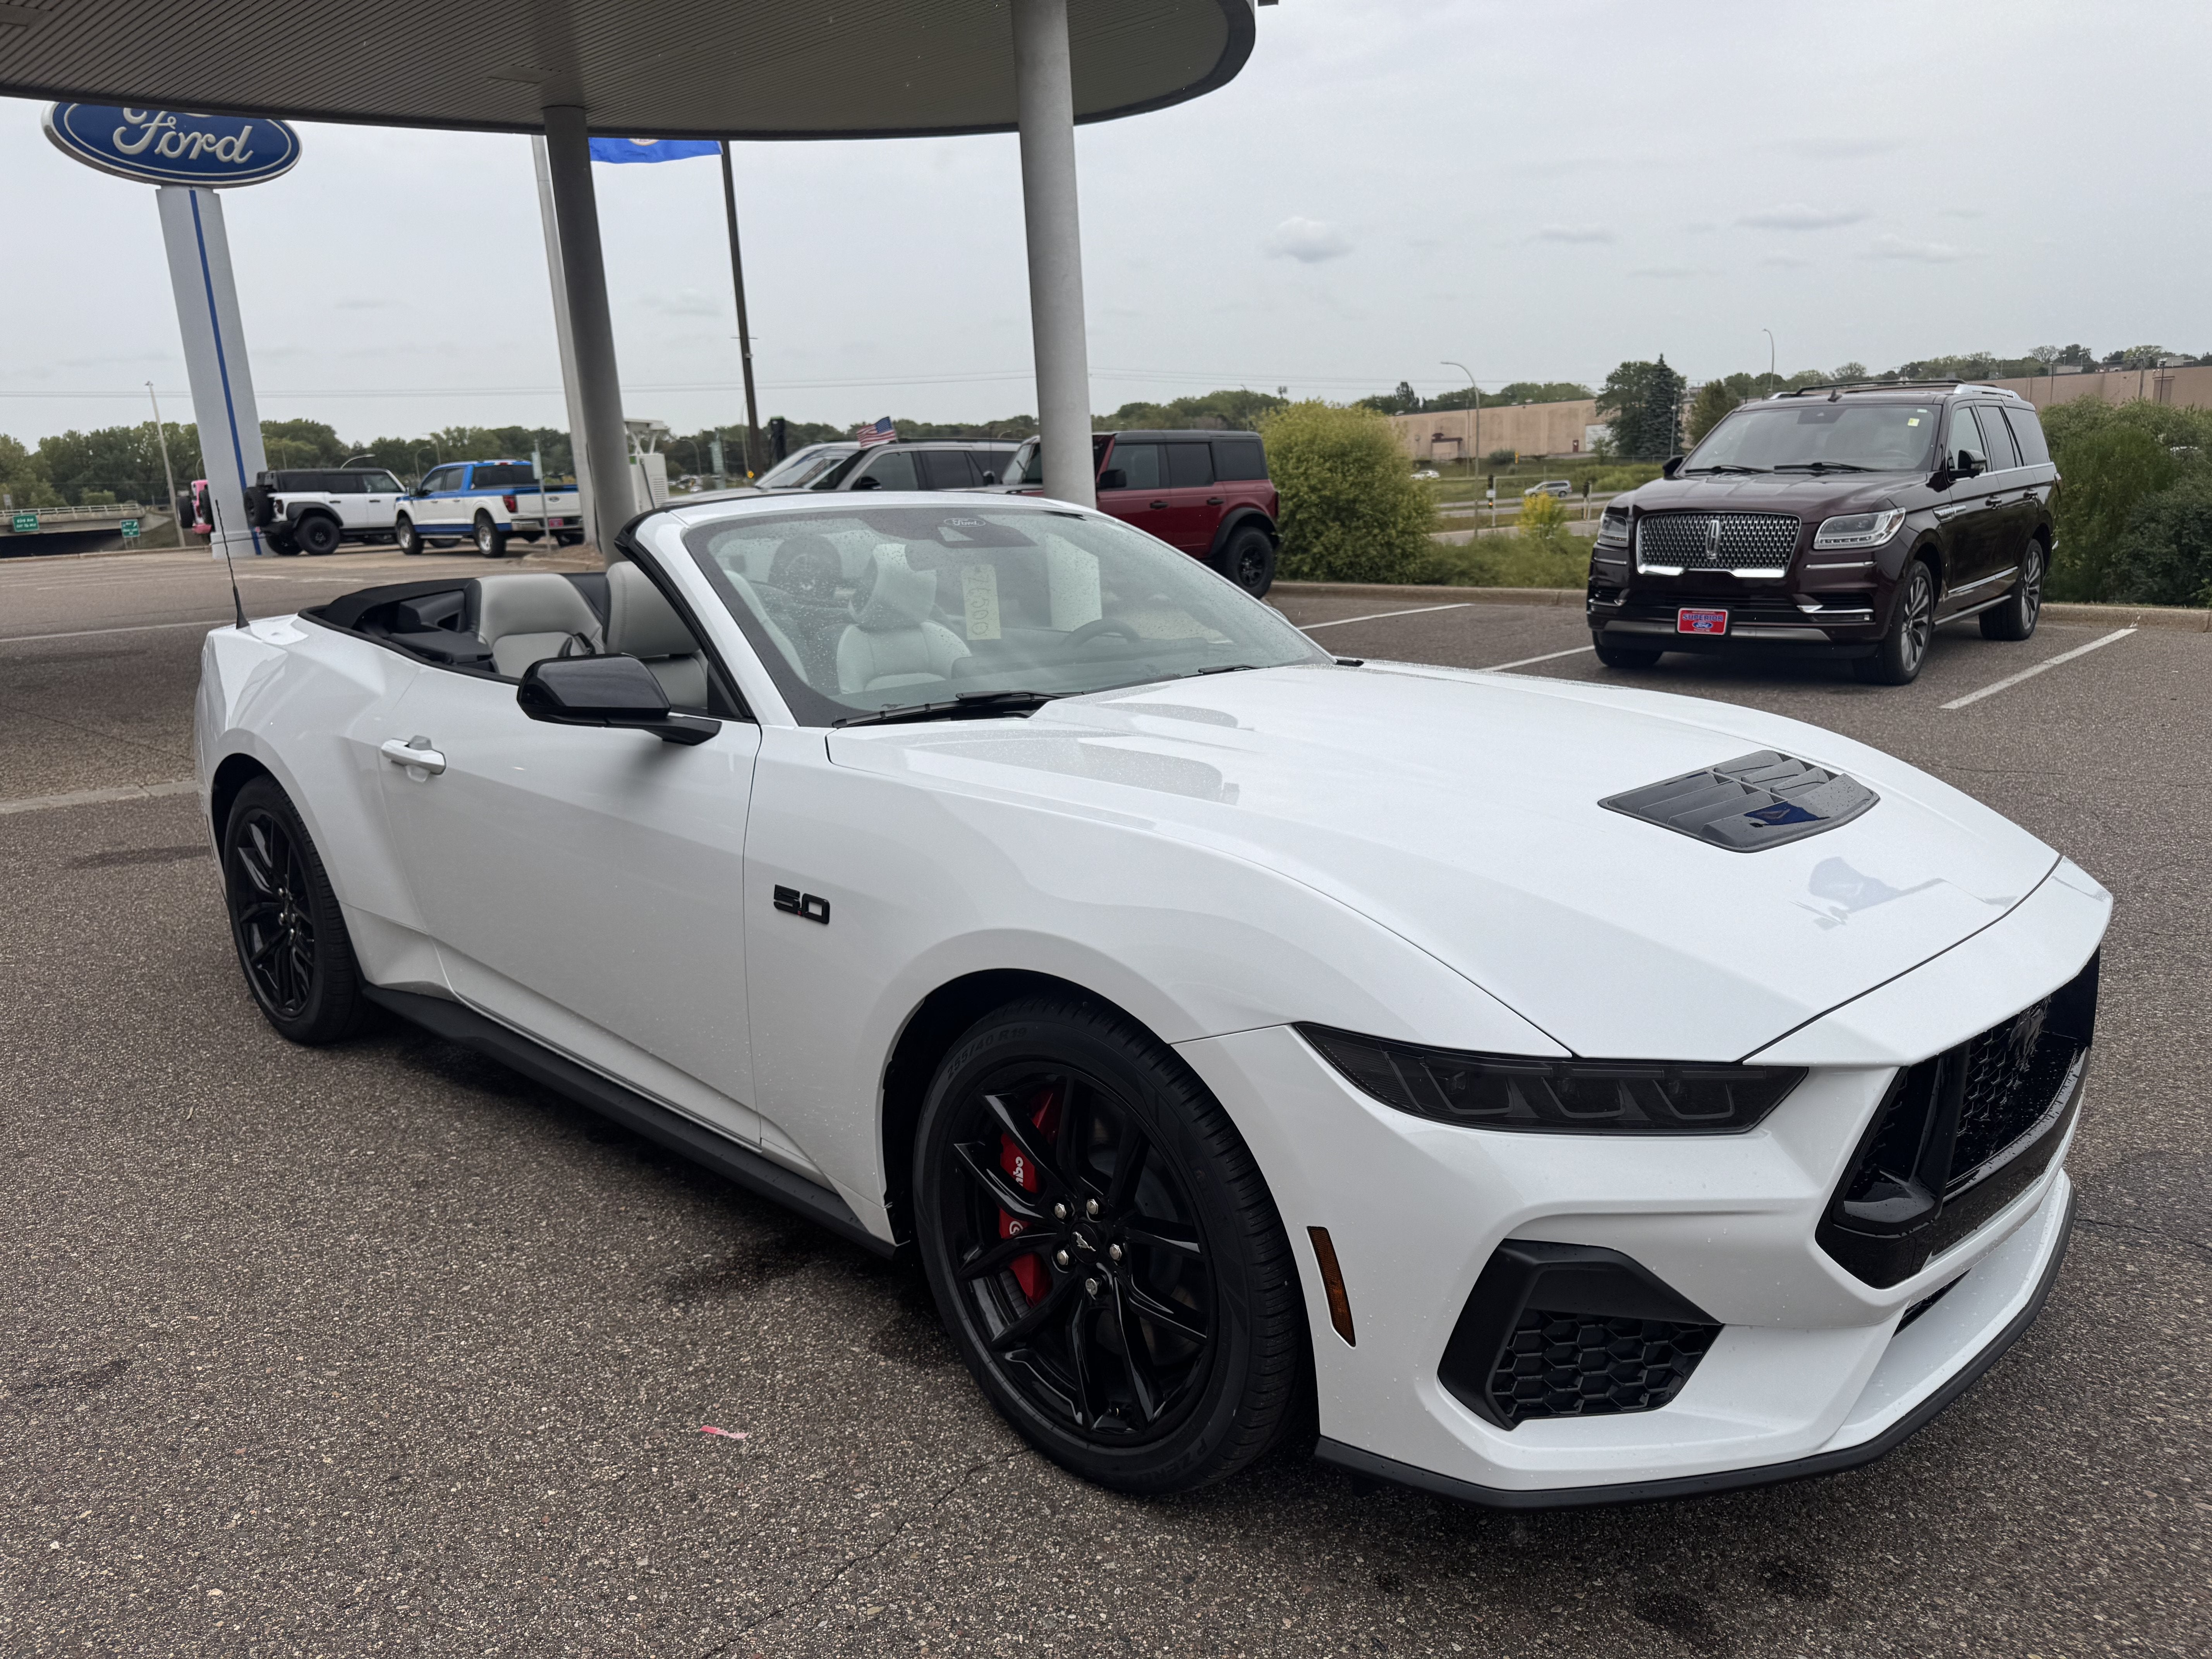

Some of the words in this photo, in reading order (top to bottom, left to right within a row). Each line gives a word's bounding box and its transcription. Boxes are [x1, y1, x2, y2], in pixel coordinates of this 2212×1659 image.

[113, 108, 254, 164] Ford
[1682, 613, 1723, 622] SUPERIOR
[947, 1034, 994, 1080] 255/40
[998, 1027, 1028, 1041] R19
